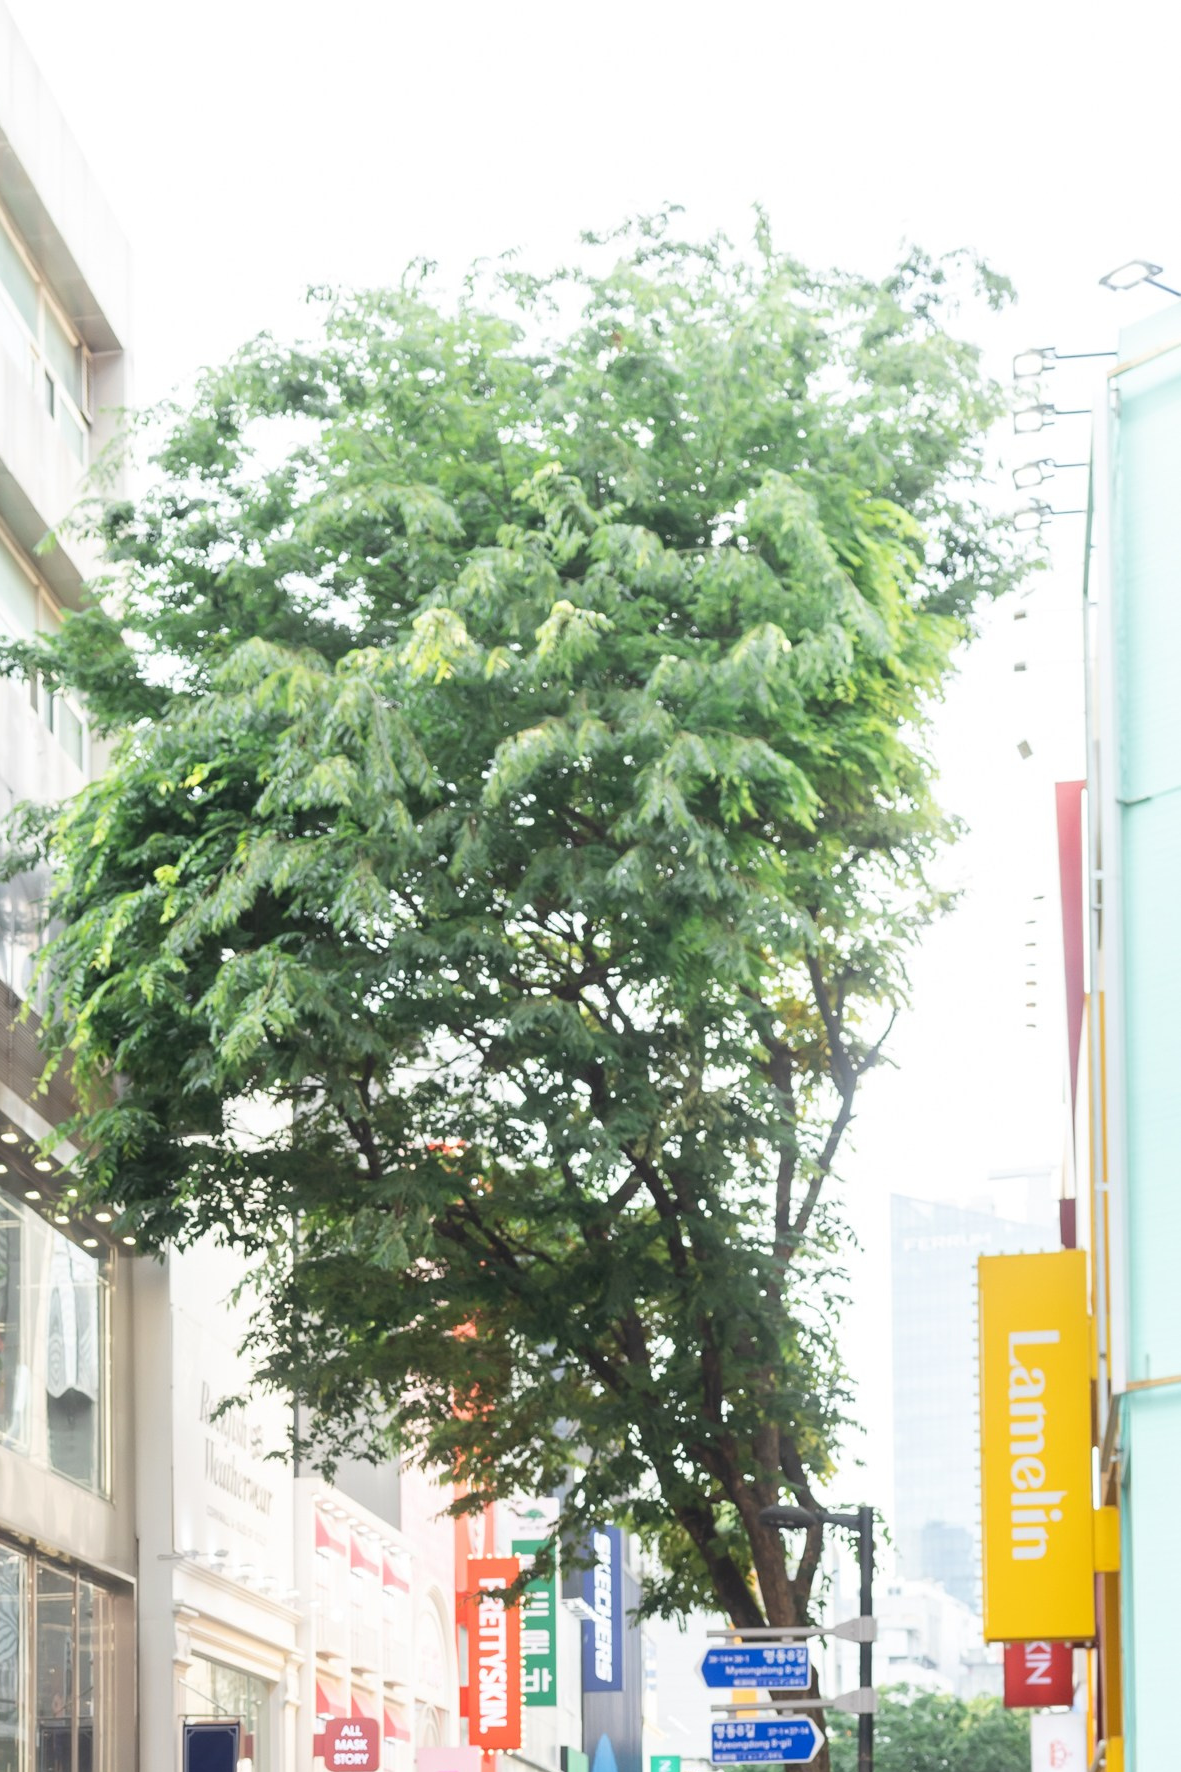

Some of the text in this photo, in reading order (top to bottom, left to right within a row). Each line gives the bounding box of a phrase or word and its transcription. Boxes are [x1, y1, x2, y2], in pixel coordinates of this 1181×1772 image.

[1008, 1328, 1064, 1562] Lamelin
[594, 1532, 613, 1682] SKECHERS
[725, 1665, 783, 1677] Myeongdong
[340, 1724, 363, 1737] ALL
[334, 1738, 368, 1751] MASK
[713, 1739, 770, 1750] Myeongdong
[333, 1752, 369, 1765] STORY
